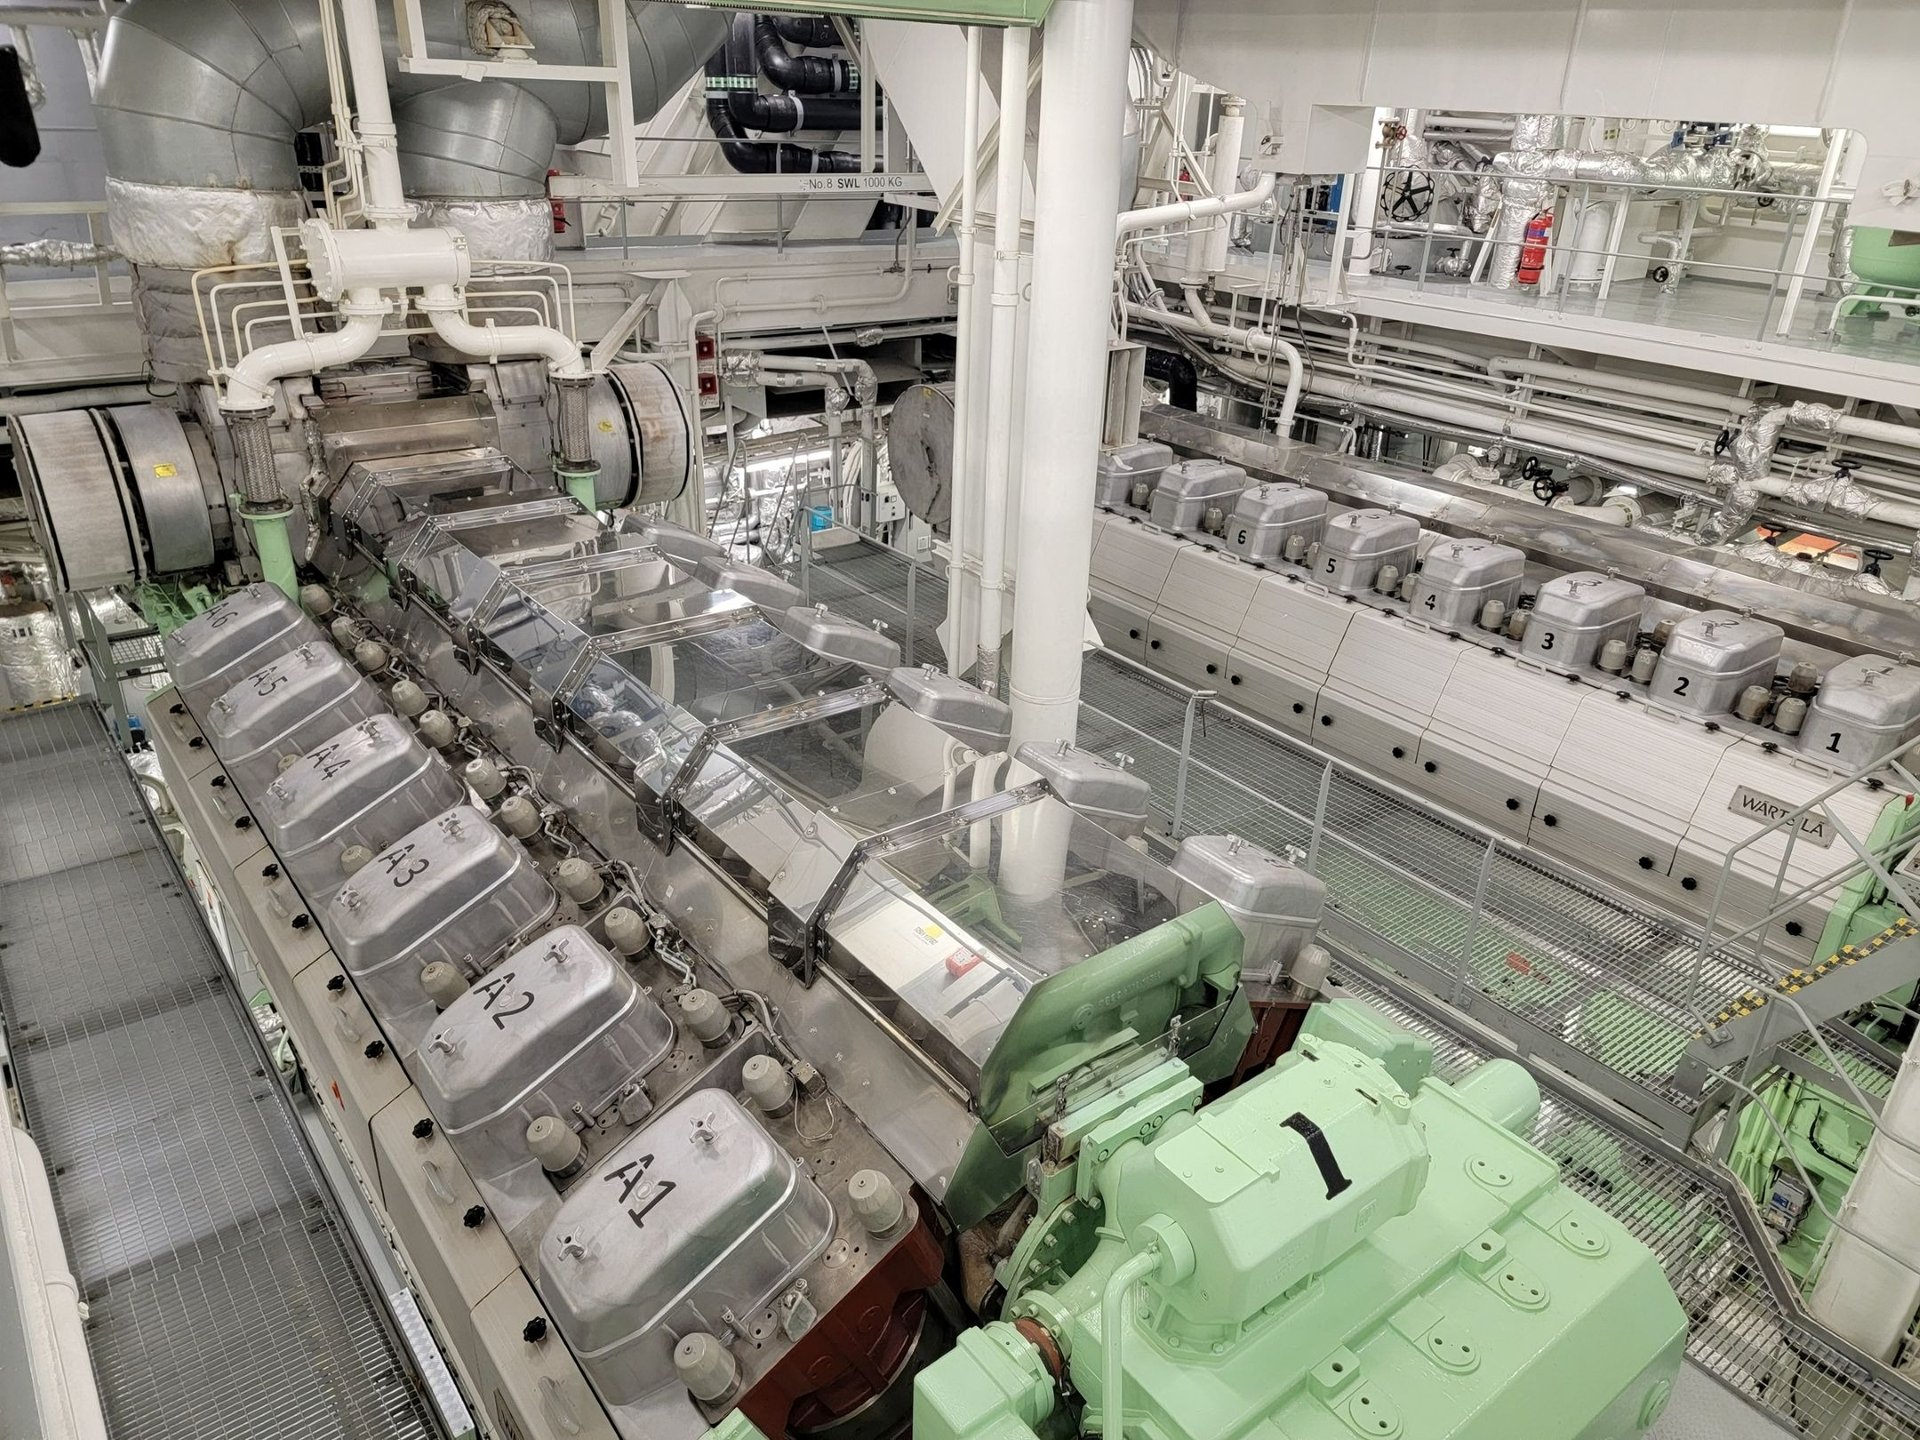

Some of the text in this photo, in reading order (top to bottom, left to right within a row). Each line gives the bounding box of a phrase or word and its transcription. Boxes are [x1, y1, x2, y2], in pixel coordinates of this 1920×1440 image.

[837, 178, 860, 189] SWL
[864, 177, 885, 188] 1000
[888, 177, 902, 187] KG
[1237, 530, 1247, 544] 6
[1325, 558, 1336, 573] 5
[1425, 594, 1436, 610] 4
[202, 602, 238, 628] A6
[1541, 632, 1555, 650] 3
[248, 666, 288, 696] A5
[1673, 676, 1690, 697] 2
[1826, 732, 1841, 753] 1
[307, 743, 351, 781] A4
[377, 843, 430, 888] A3
[473, 972, 535, 1031] A2
[1279, 1111, 1353, 1201] 1
[603, 1153, 677, 1229] A1
